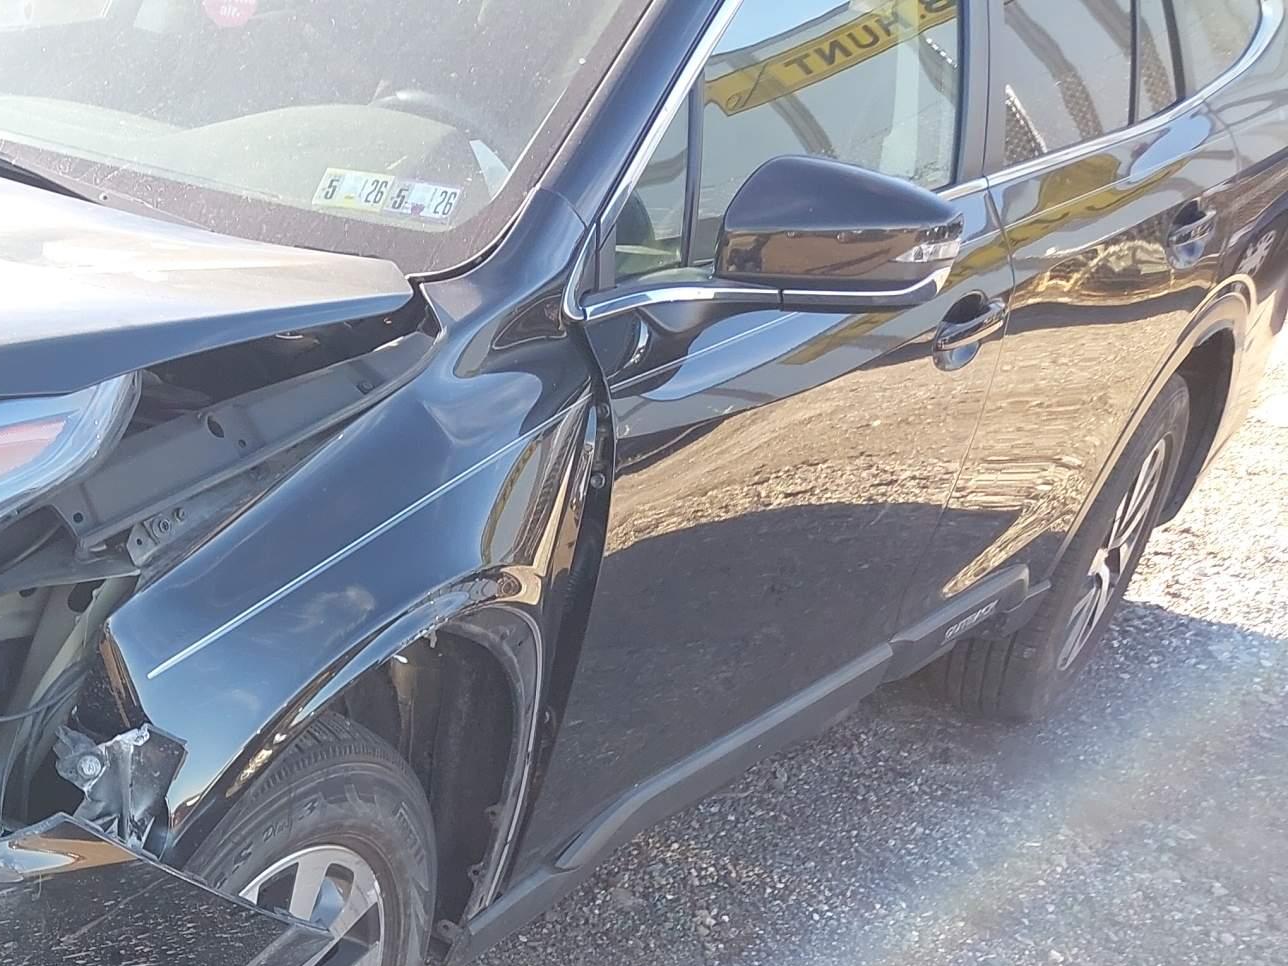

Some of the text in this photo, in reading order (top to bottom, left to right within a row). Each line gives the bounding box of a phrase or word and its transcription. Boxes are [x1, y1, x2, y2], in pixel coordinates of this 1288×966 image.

[324, 178, 389, 204] 5 26
[433, 190, 458, 216] 26
